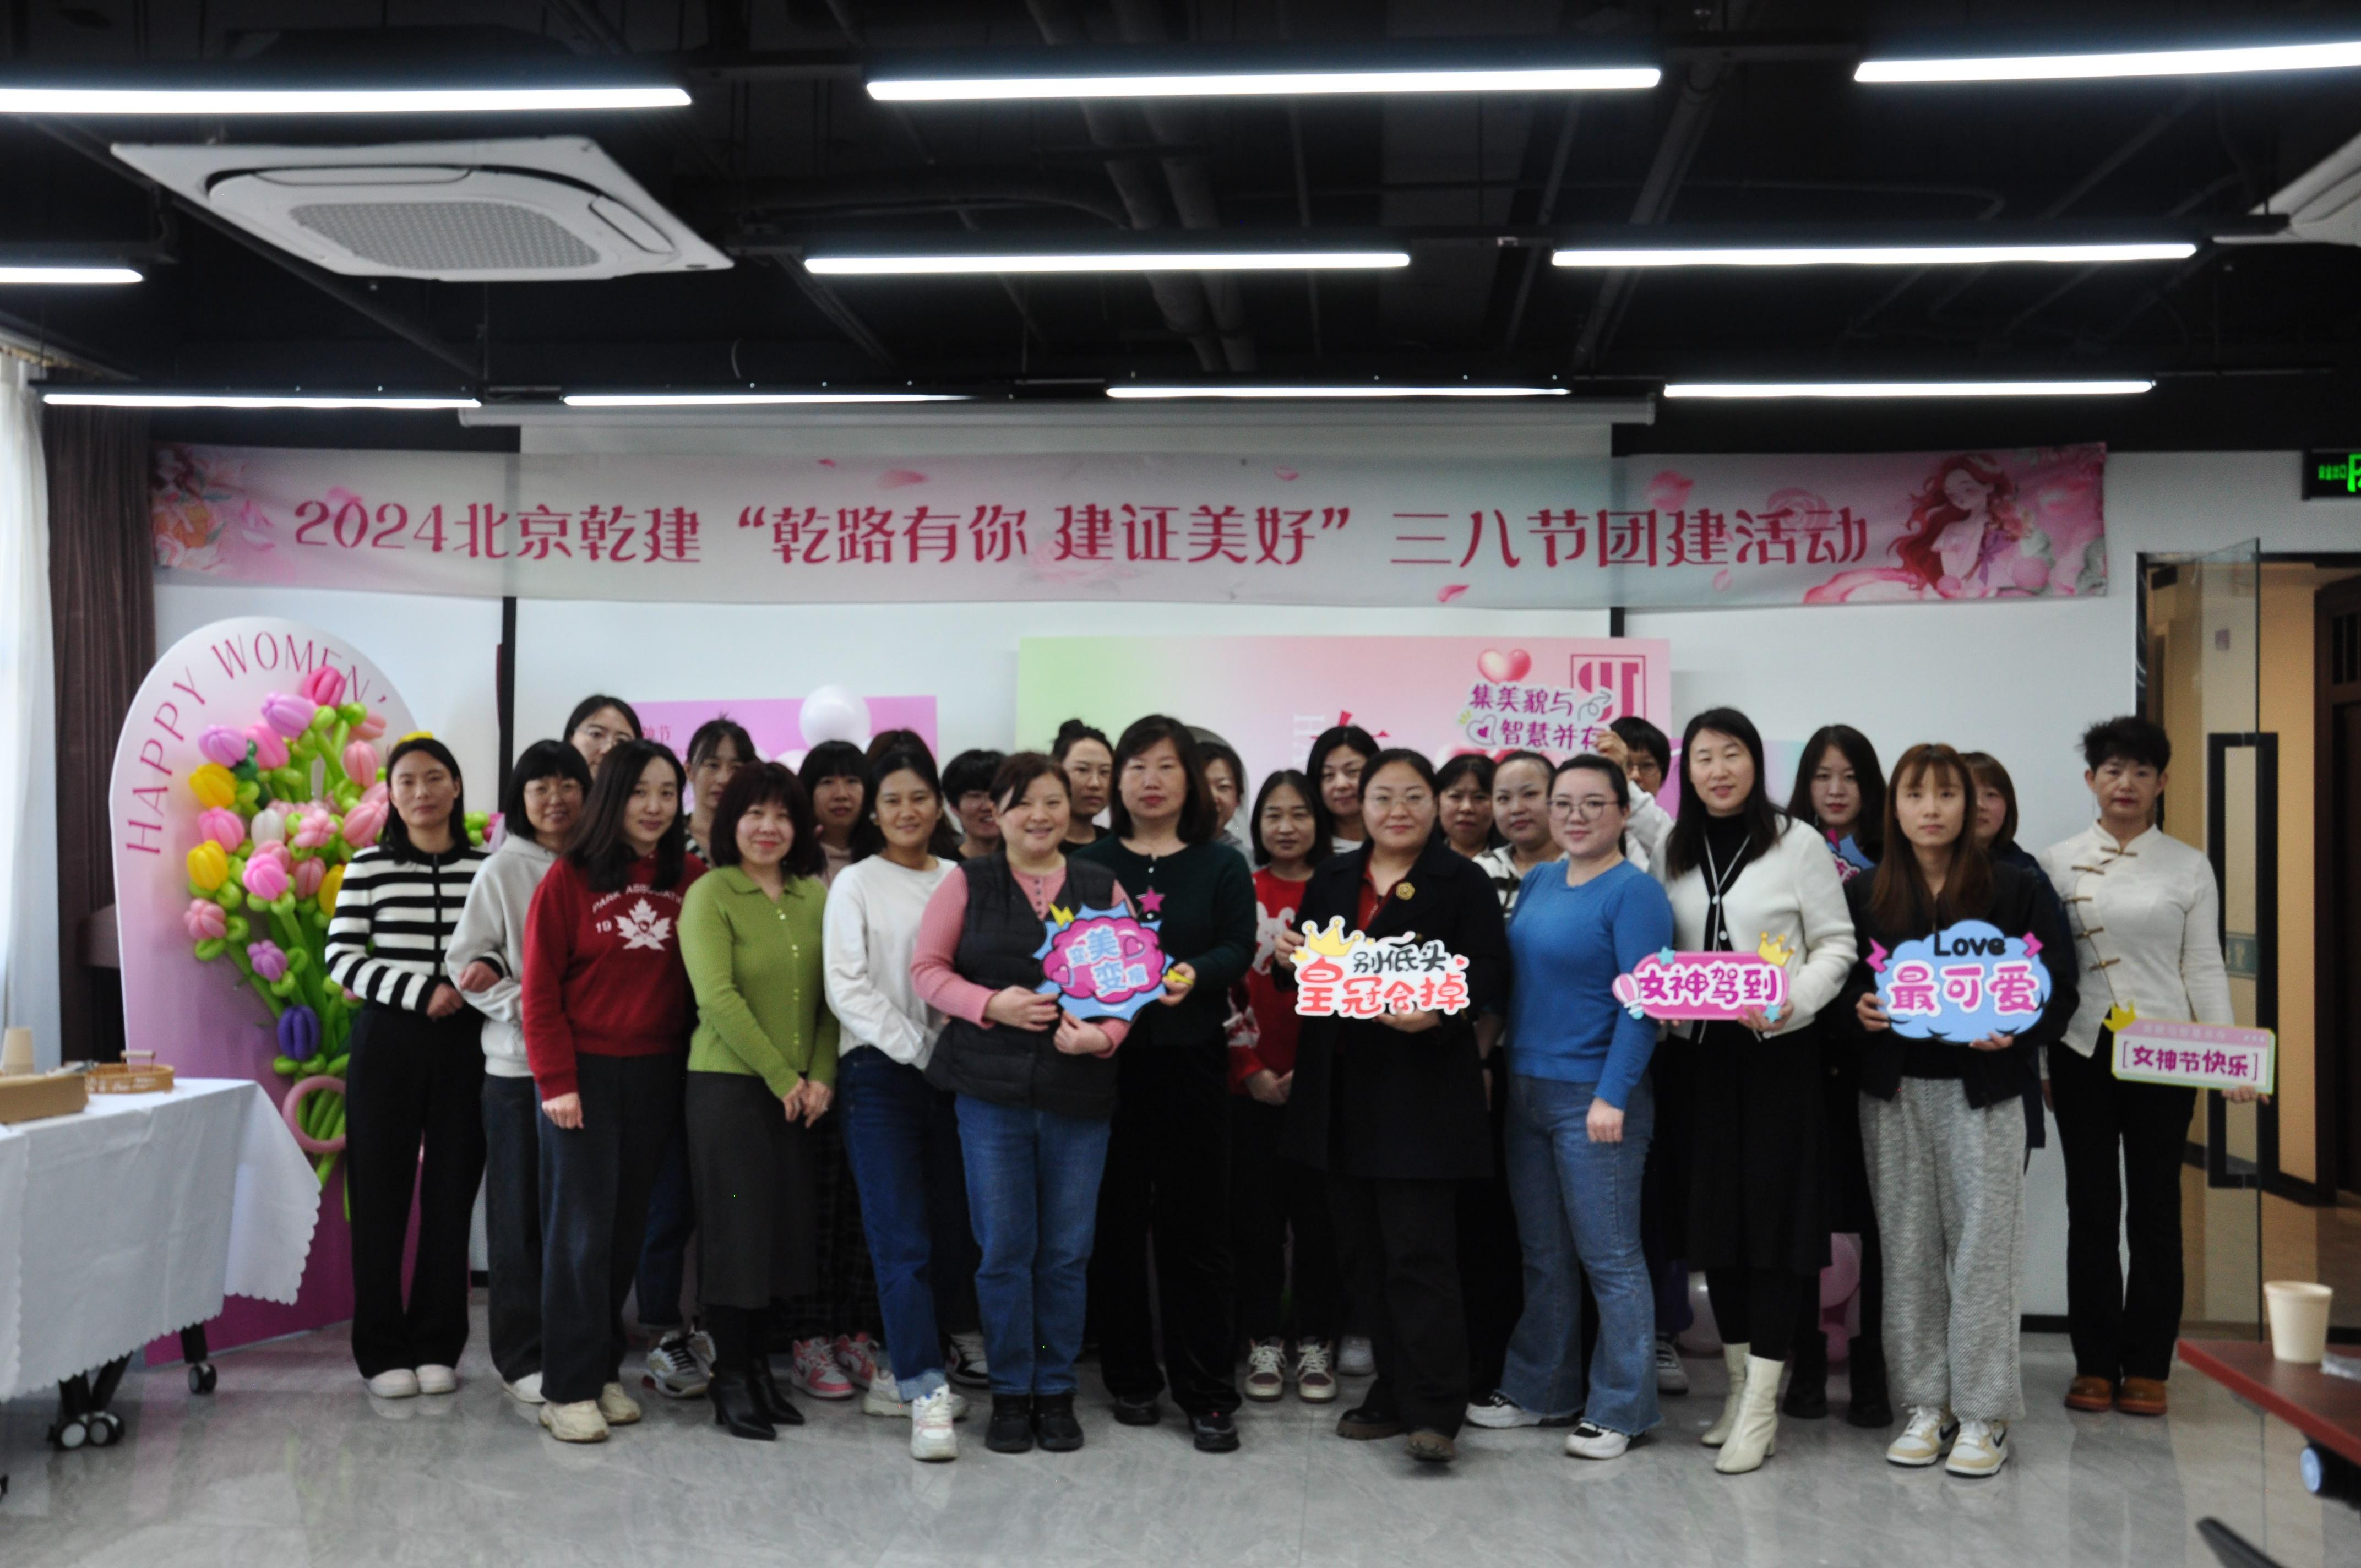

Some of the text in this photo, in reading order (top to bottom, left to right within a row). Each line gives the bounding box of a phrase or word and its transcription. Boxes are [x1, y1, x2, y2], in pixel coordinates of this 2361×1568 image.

[293, 500, 700, 563] 2024北京乾建
[1390, 506, 1869, 569] 三八节团建活动
[1470, 683, 1574, 717] 集美貌与
[126, 666, 205, 854] HAPPY
[1353, 944, 1448, 973] 别低头
[1934, 932, 2006, 956] Love
[1299, 956, 1466, 1015] 皇冠会掉
[1639, 966, 1777, 1005] 女神驾到
[1890, 965, 2037, 1012] 最可爱
